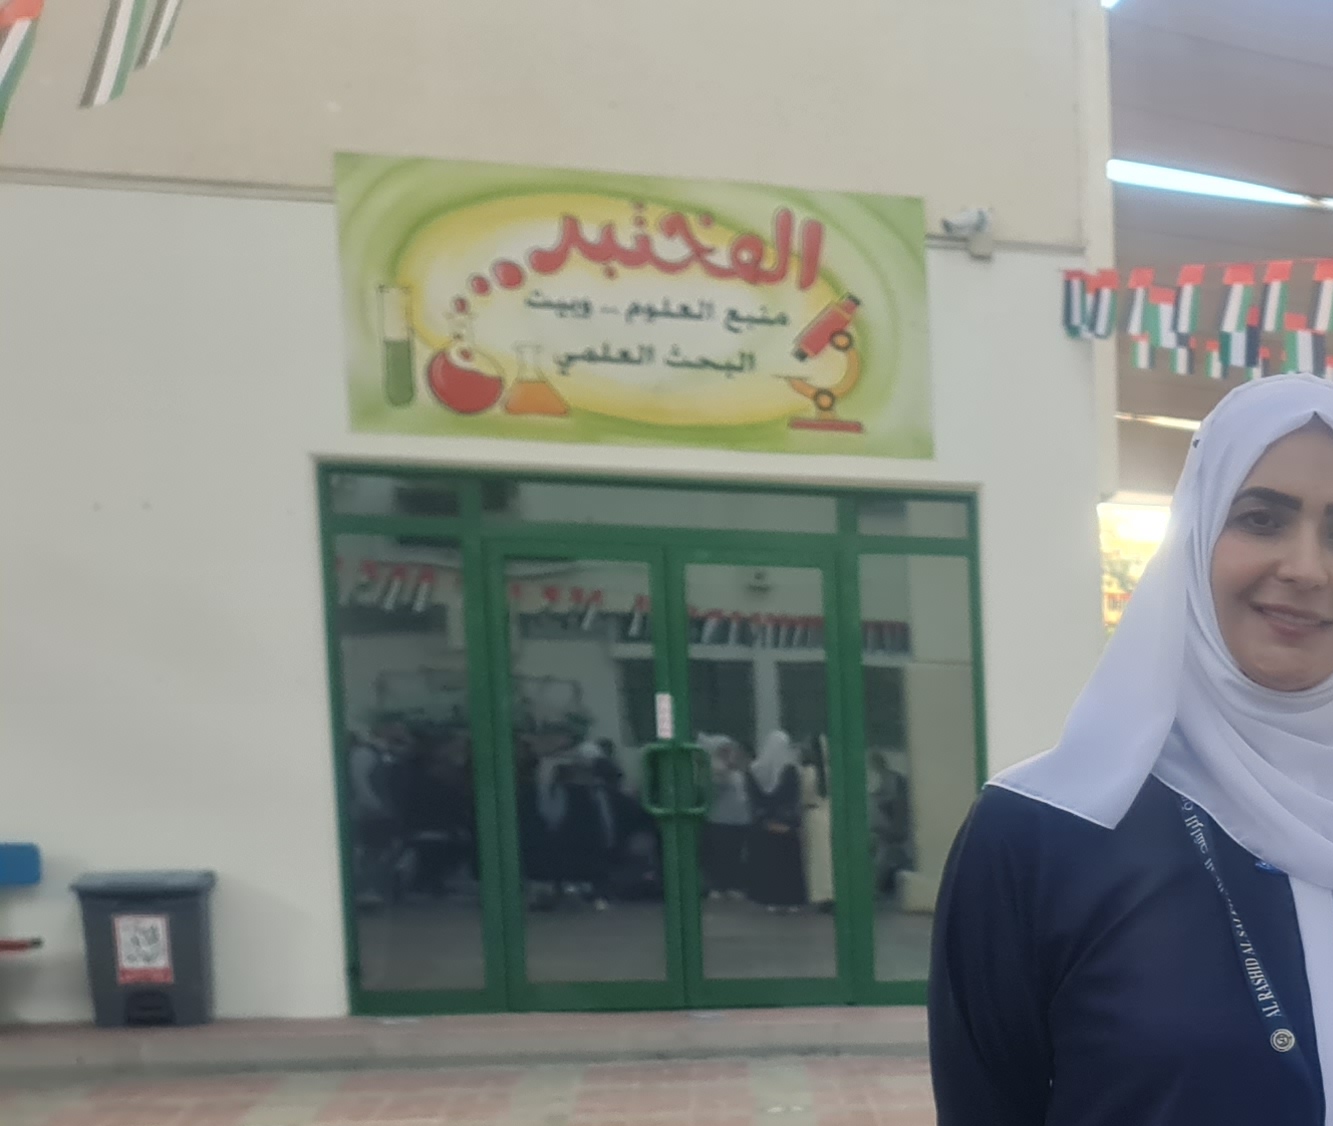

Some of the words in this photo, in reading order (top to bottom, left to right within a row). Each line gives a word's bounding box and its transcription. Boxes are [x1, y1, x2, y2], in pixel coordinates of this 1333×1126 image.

[625, 298, 715, 324] العلوم
[724, 304, 789, 333] منبع
[554, 343, 656, 376] العلمي
[666, 344, 757, 379] البحث
